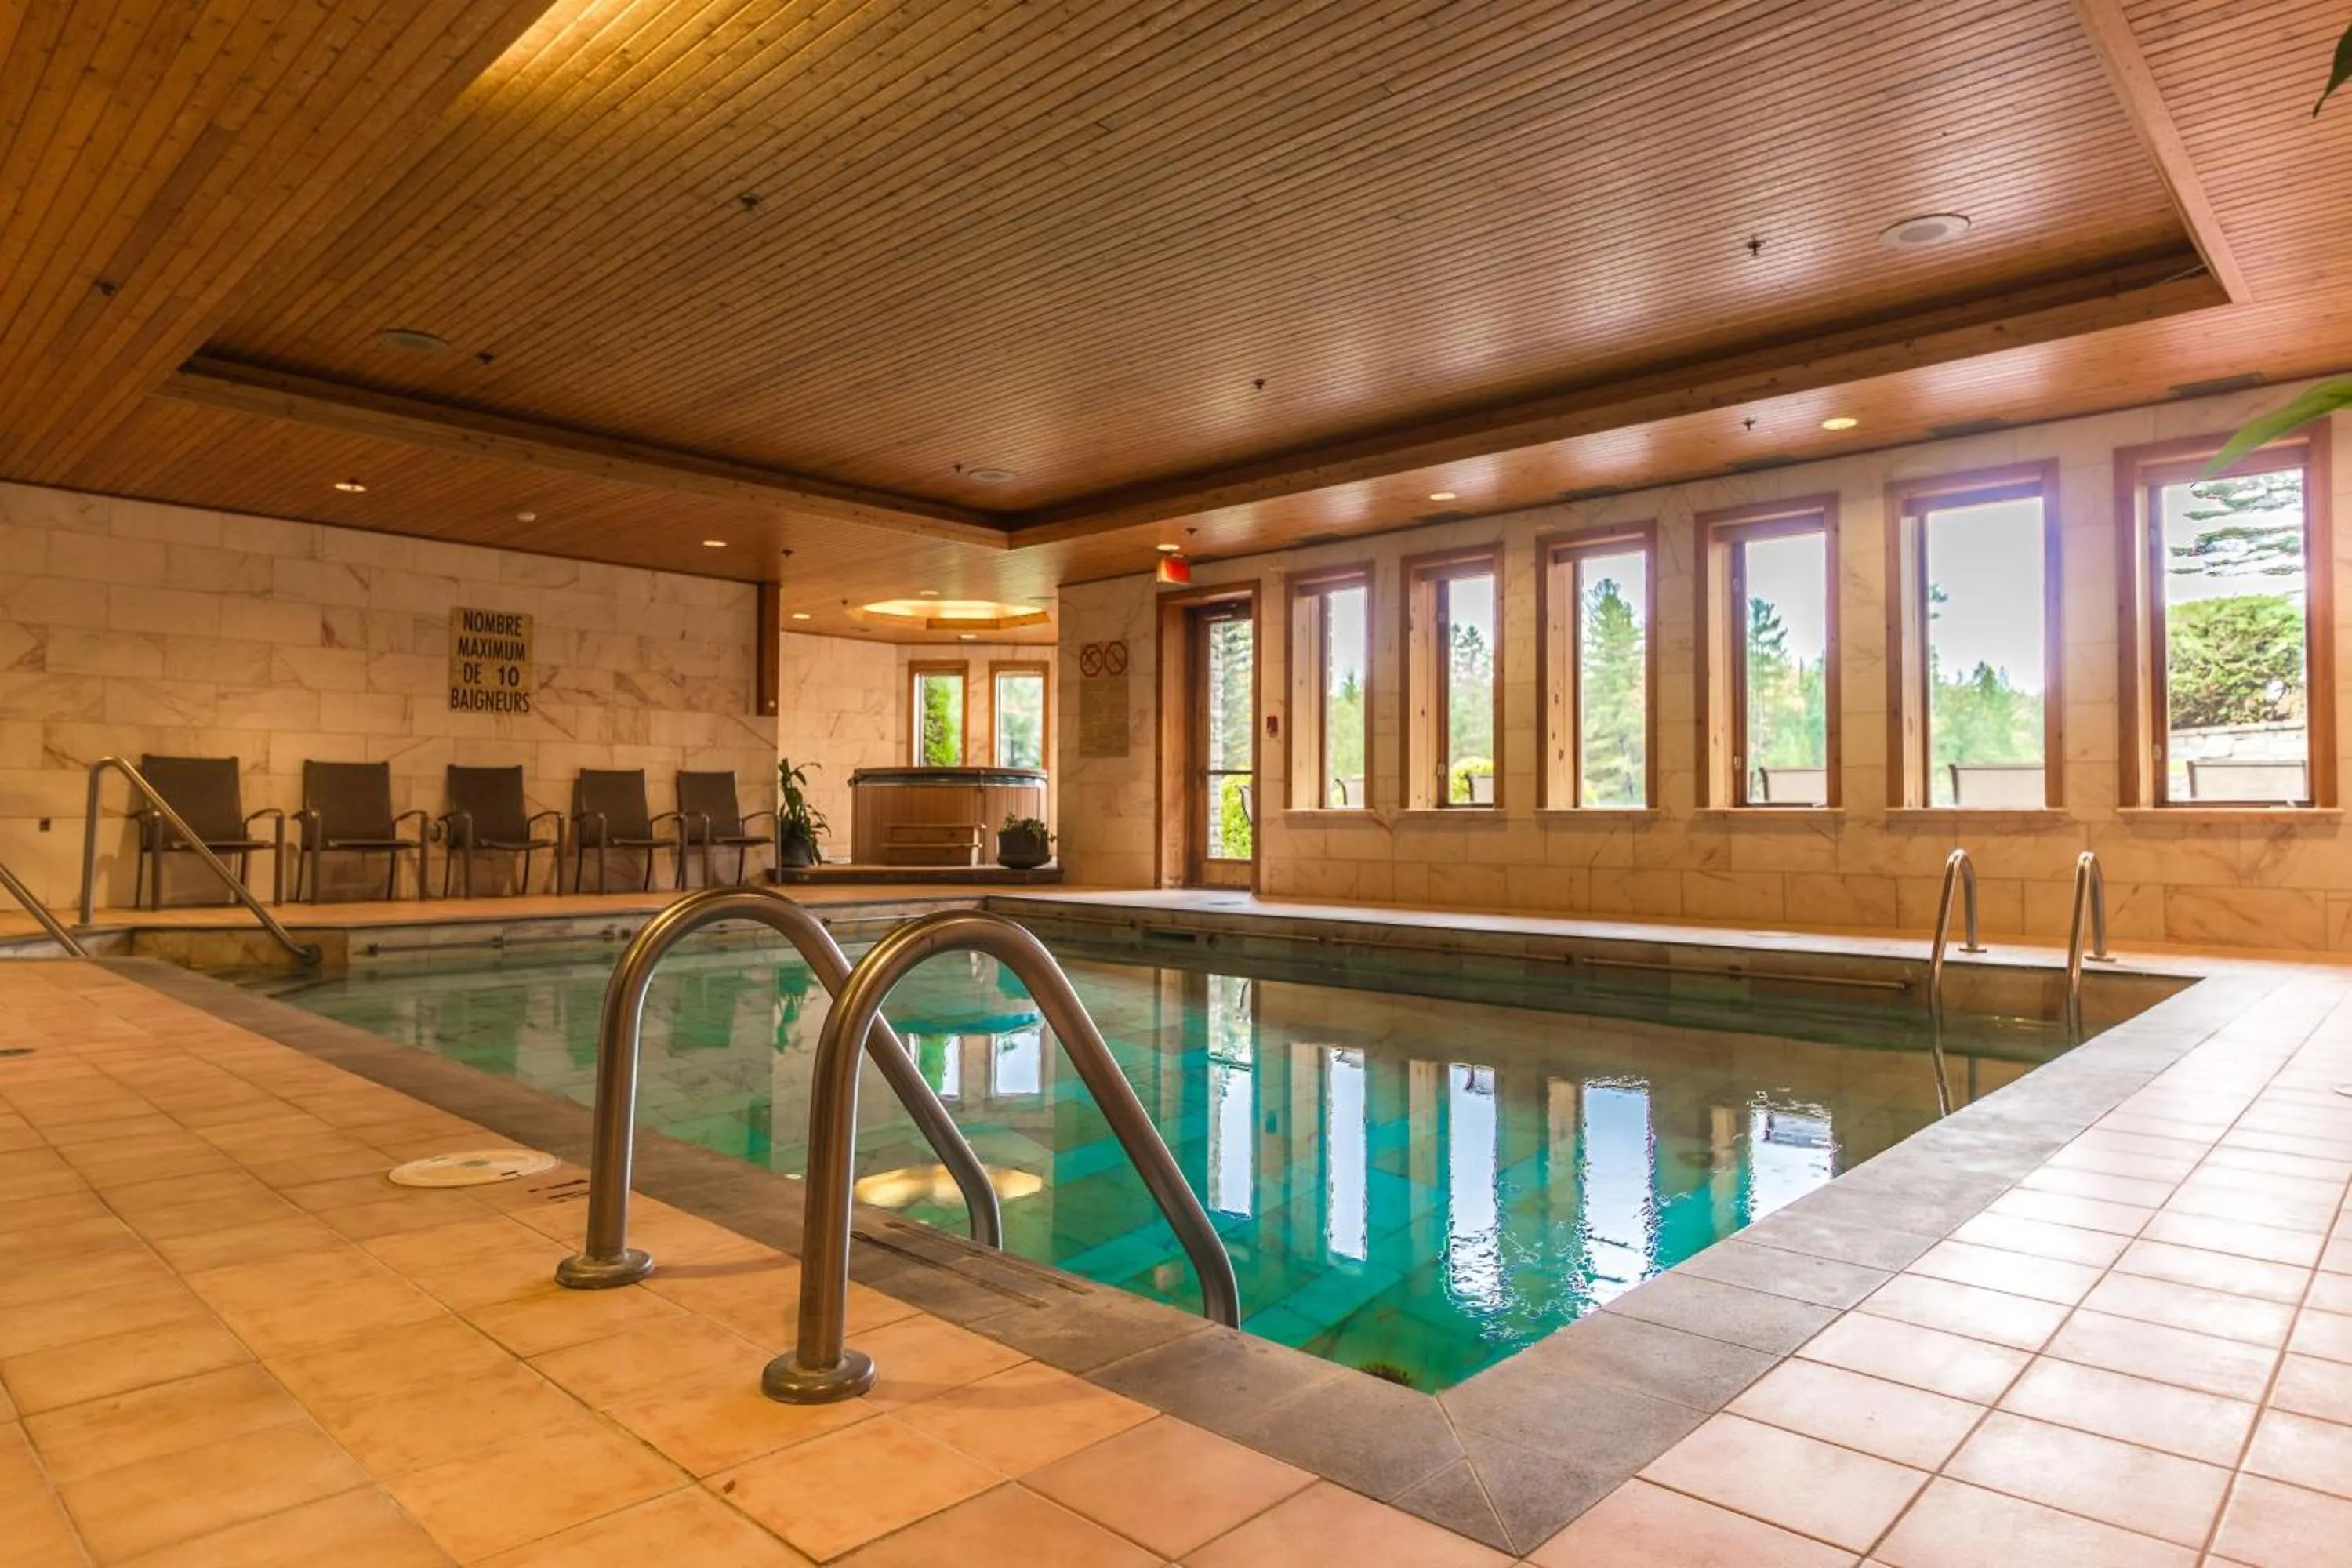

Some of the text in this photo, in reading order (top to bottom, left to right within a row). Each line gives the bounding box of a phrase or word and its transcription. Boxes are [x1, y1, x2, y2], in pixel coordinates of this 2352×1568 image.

[463, 611, 522, 637] NOMBRE
[458, 637, 526, 662] MAXIMUM
[463, 662, 519, 687] DE 10
[451, 688, 530, 713] BAIGNEURS
